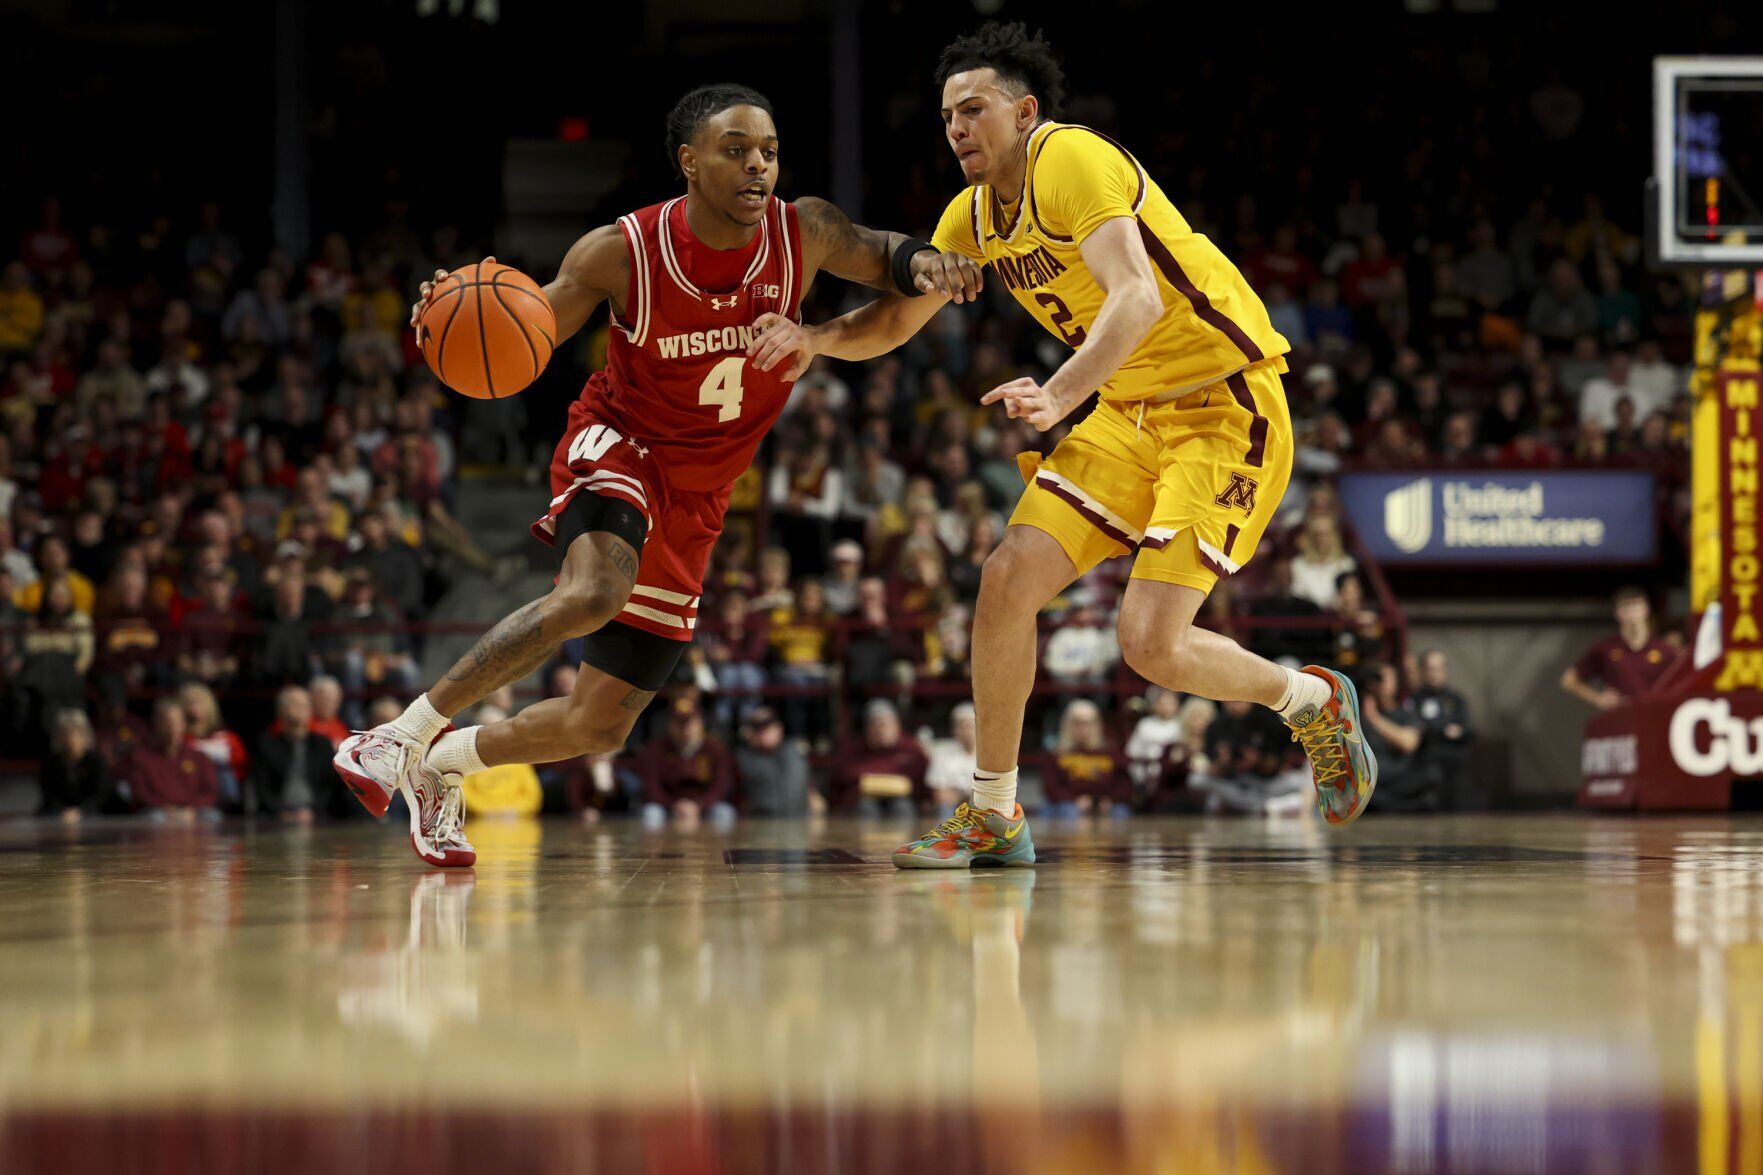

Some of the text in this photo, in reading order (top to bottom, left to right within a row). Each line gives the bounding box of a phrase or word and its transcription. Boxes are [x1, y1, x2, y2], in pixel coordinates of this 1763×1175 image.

[657, 318, 772, 359] WISCON
[1035, 293, 1087, 348] 2
[698, 357, 747, 423] 4
[567, 423, 624, 468] W
[1443, 482, 1543, 517] United
[1727, 379, 1759, 642] MINNESOTA
[1444, 517, 1604, 547] Healthcare
